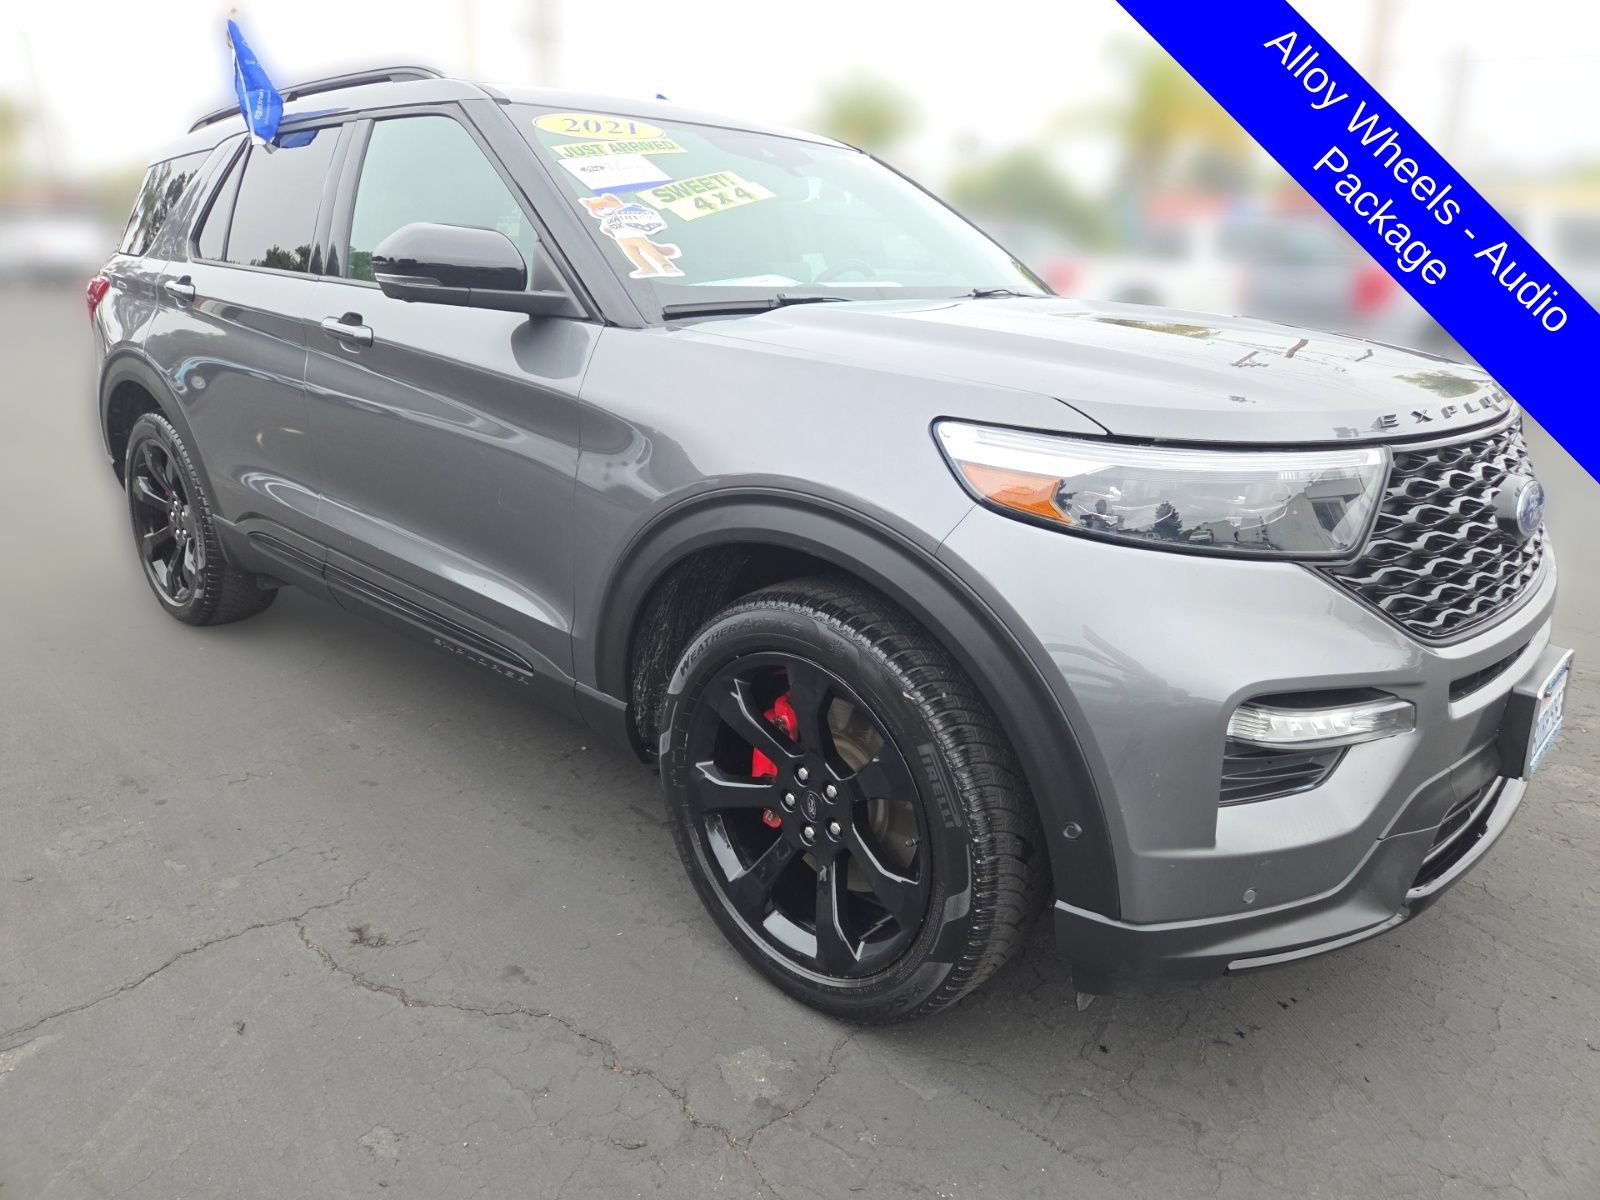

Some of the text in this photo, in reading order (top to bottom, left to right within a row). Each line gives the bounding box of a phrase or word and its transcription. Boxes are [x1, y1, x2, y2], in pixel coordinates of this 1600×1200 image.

[561, 118, 638, 135] 2021
[563, 140, 675, 158] JUST ARRIVED
[651, 174, 736, 203] SWEET!
[917, 743, 962, 829] PIRELLI
